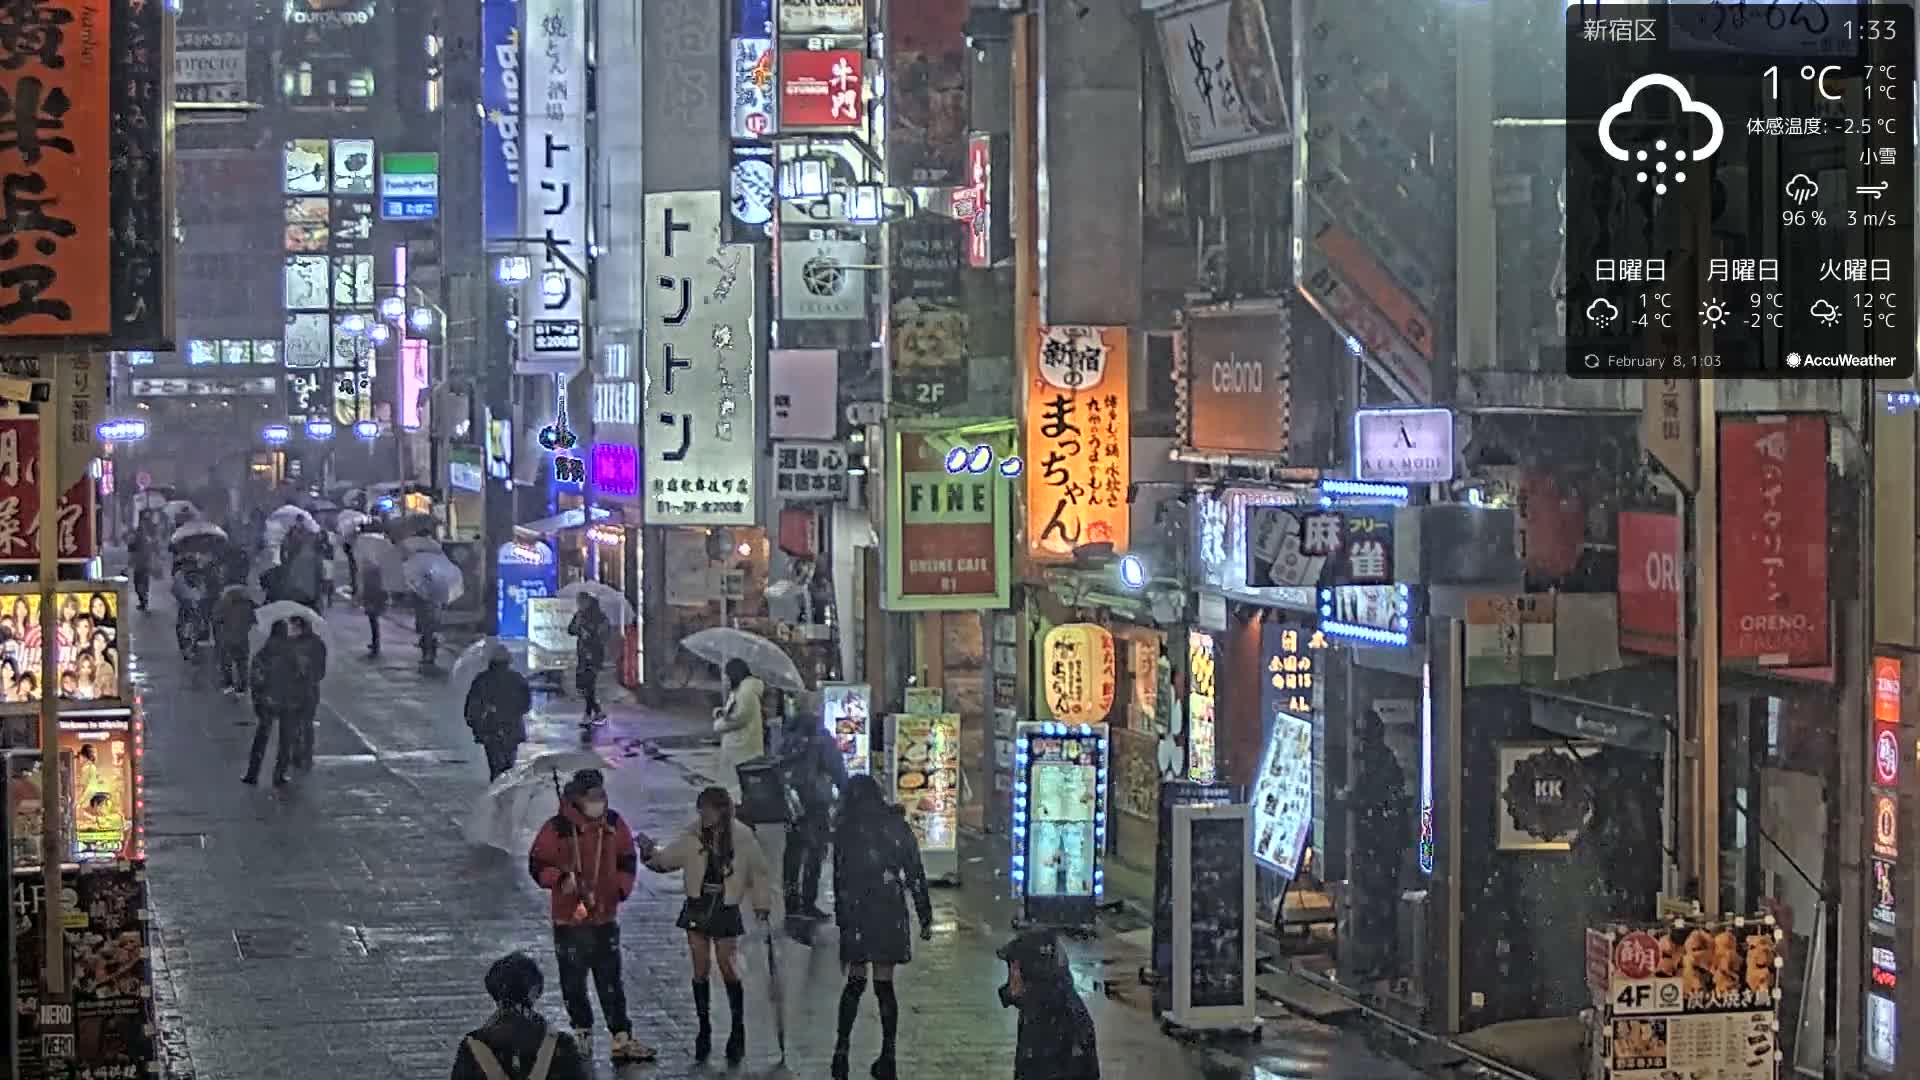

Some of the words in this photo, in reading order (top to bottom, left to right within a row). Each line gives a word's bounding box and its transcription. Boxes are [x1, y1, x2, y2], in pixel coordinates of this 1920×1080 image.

[658, 207, 693, 462] トントン
[917, 383, 944, 402] 2F
[1041, 394, 1085, 543] まっちゃん
[911, 484, 985, 512] FINE
[1349, 517, 1389, 533] フリー
[1617, 985, 1651, 1008] 4F
